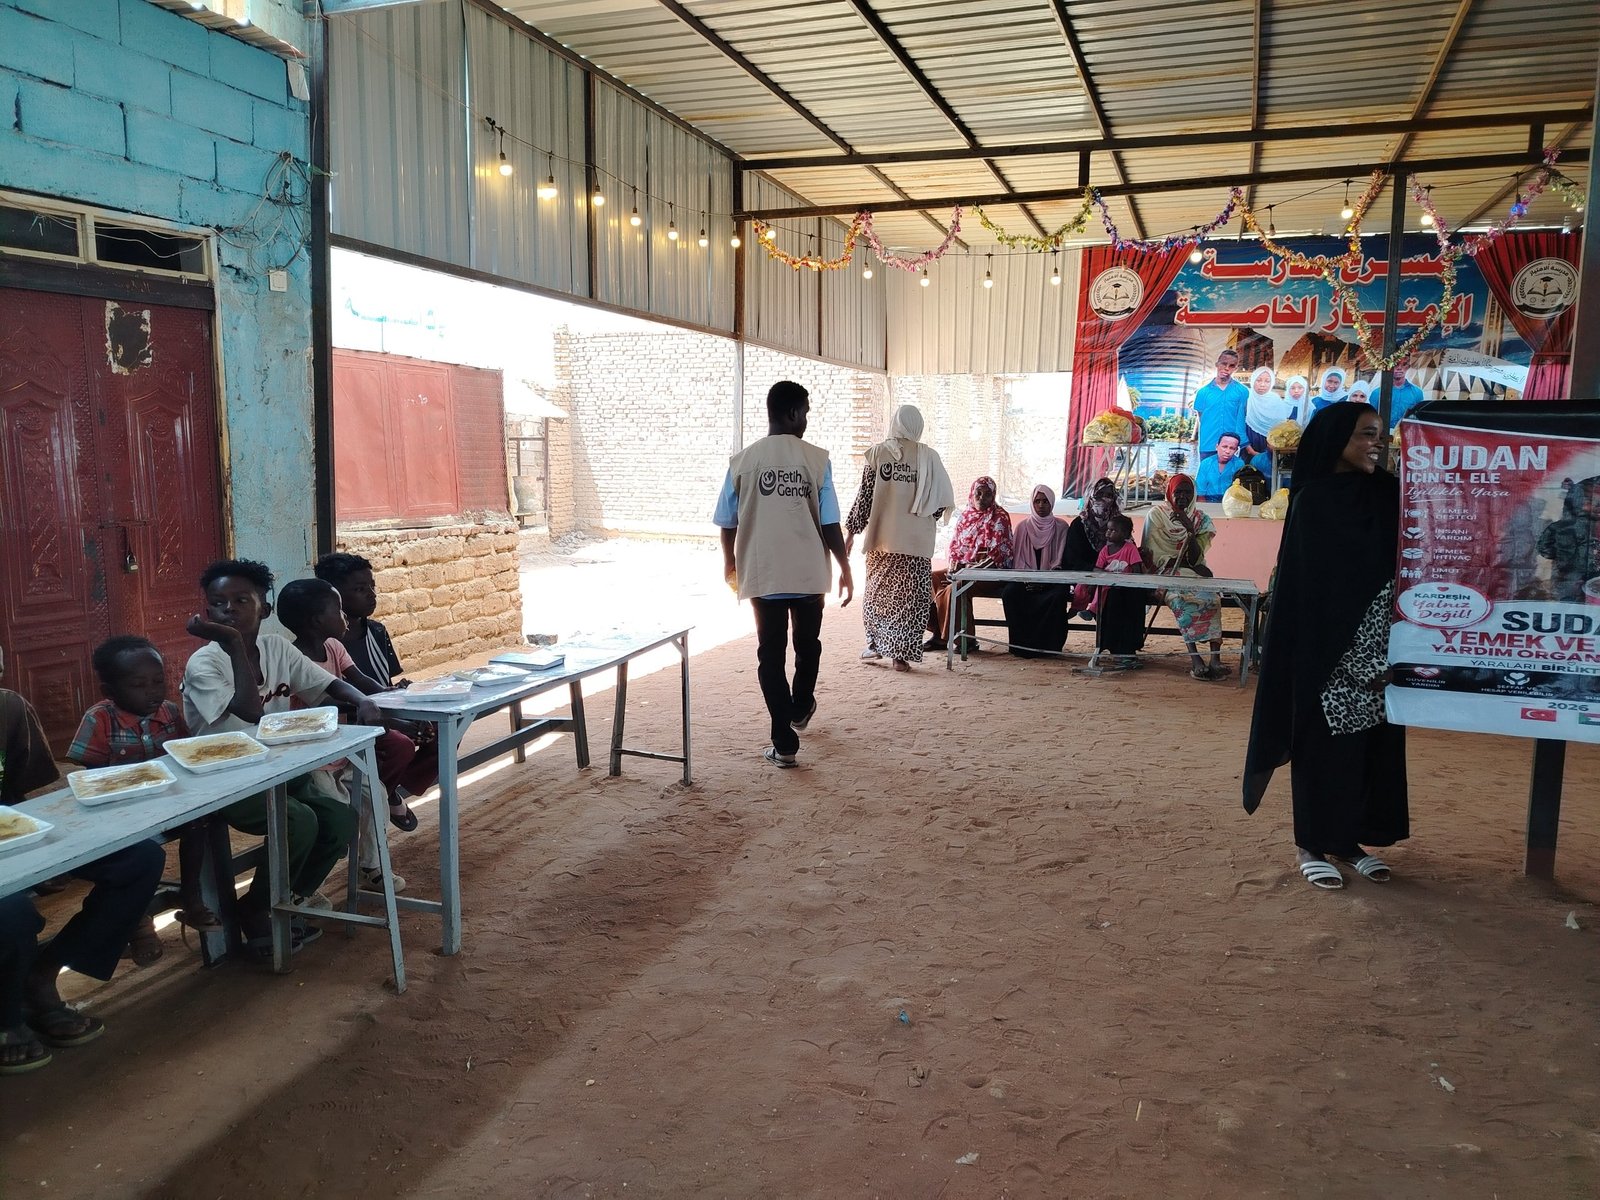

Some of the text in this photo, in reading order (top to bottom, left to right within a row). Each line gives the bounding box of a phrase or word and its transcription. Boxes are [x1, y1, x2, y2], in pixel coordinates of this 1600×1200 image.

[1175, 293, 1473, 336] الإمتاز الخاصة
[1406, 446, 1547, 470] SUDAN
[777, 469, 802, 483] Fetih
[1406, 471, 1501, 484] İÇİN EL ELE
[777, 483, 812, 499] Gençlik
[1414, 593, 1471, 601] KARDEŞİN
[1417, 609, 1473, 622] Değil!
[1502, 611, 1600, 636] SUD
[1441, 630, 1595, 652] YEMEK VE
[1432, 645, 1512, 657] YARDIM
[1471, 659, 1537, 670] YARALARI
[1548, 702, 1590, 711] 2026
